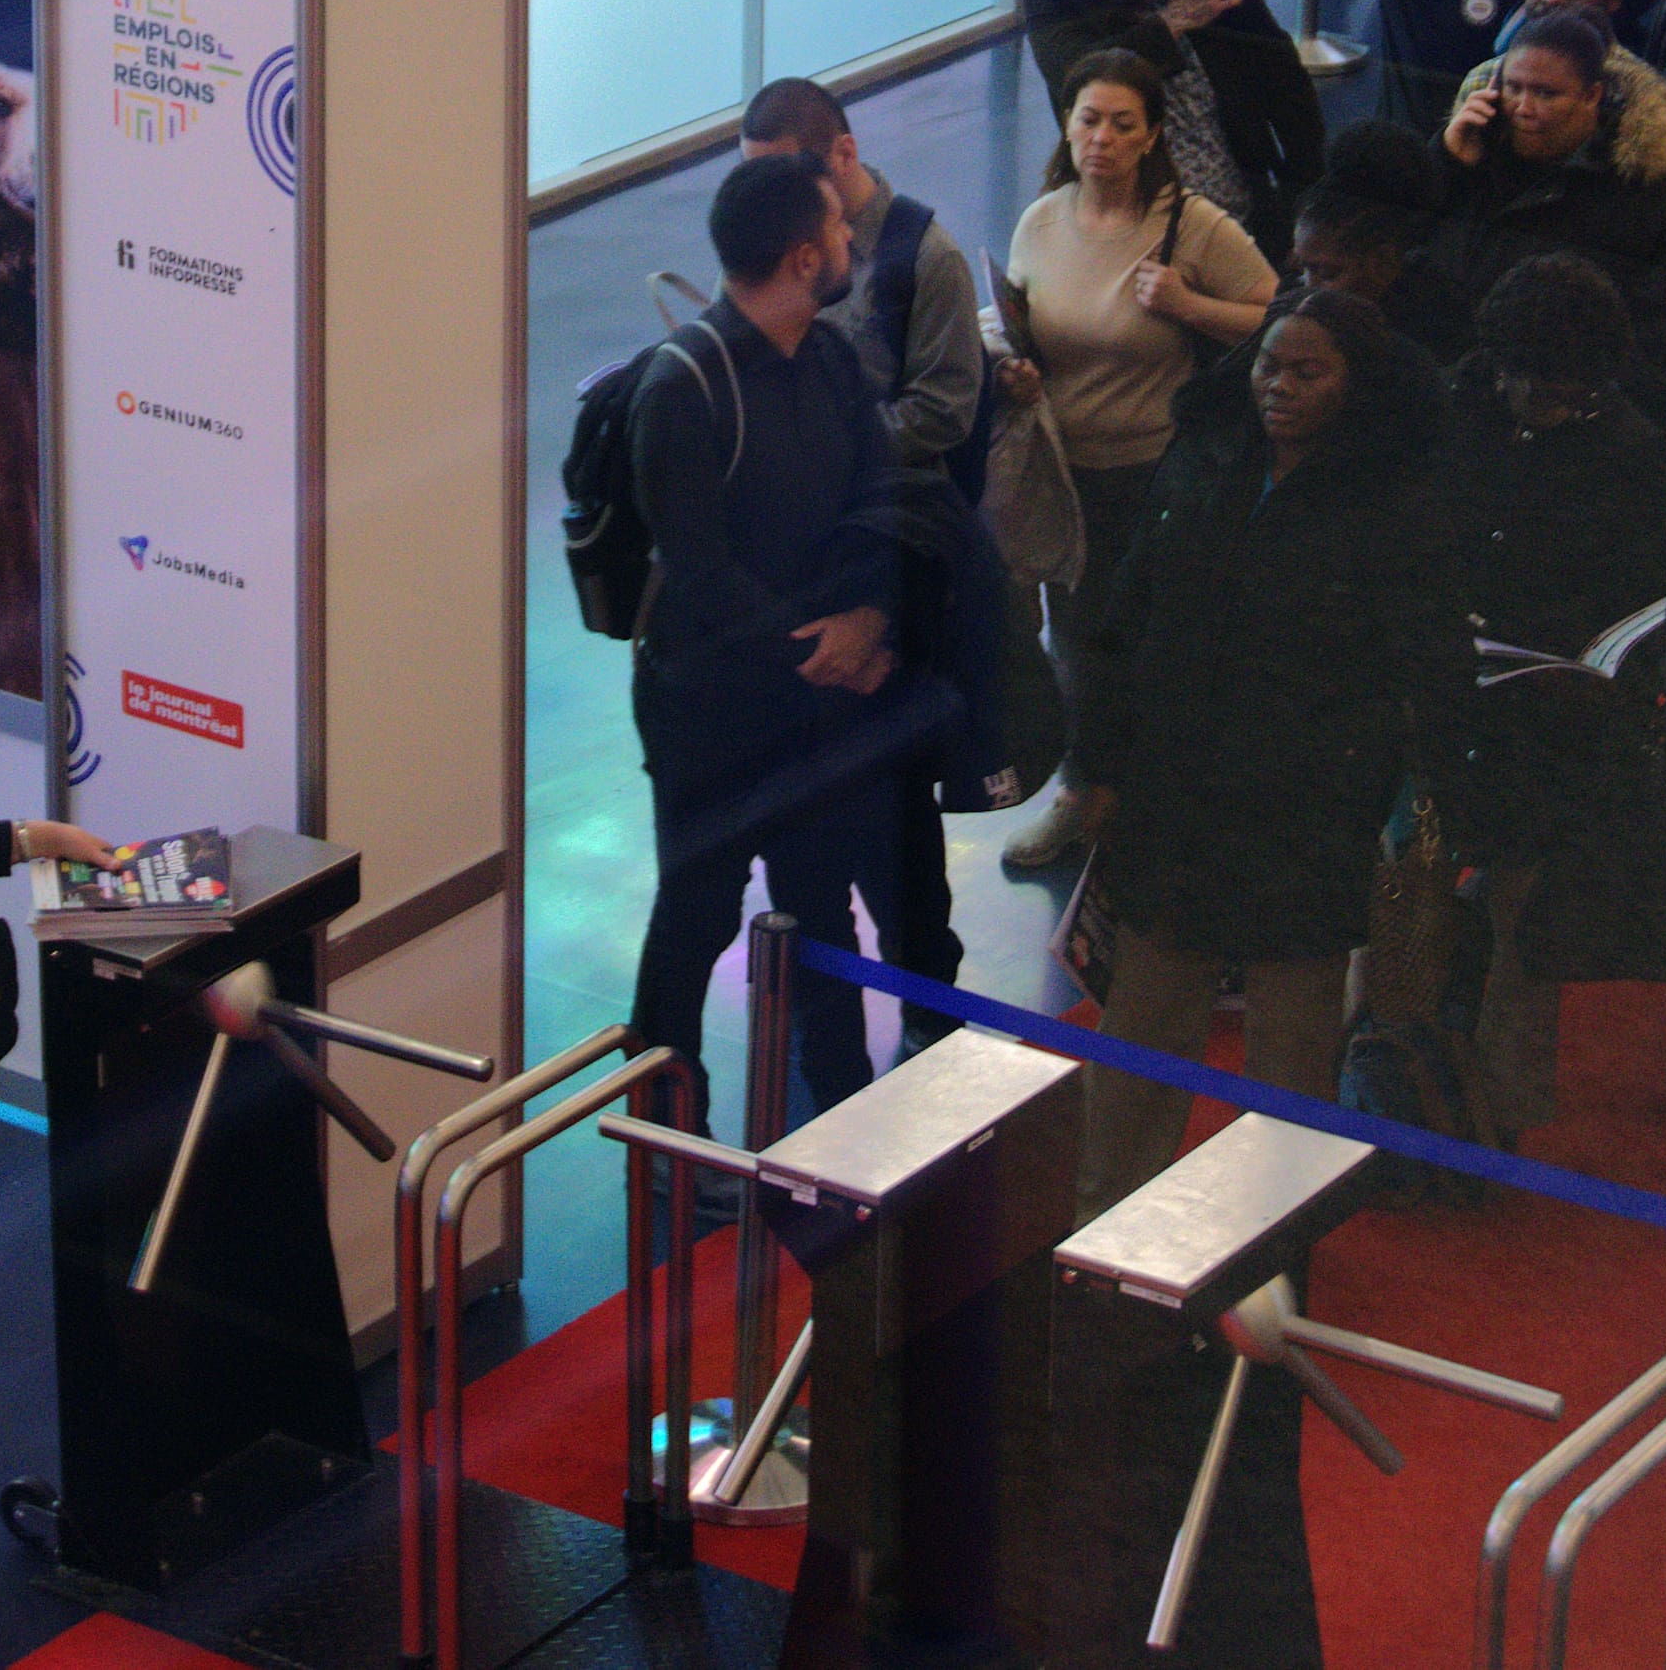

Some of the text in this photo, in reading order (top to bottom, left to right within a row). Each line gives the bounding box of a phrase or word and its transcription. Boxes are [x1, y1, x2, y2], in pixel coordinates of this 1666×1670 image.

[114, 14, 215, 54] EMPLOIS
[145, 46, 176, 70] EN
[114, 62, 215, 104] RÉGIONS
[149, 246, 243, 282] FORMATIONS
[149, 262, 237, 296] INFOPRESSE
[139, 400, 243, 440] GENIUM360
[152, 551, 245, 589] JobsMedia
[128, 681, 212, 717] le journal
[129, 696, 238, 739] de montréal
